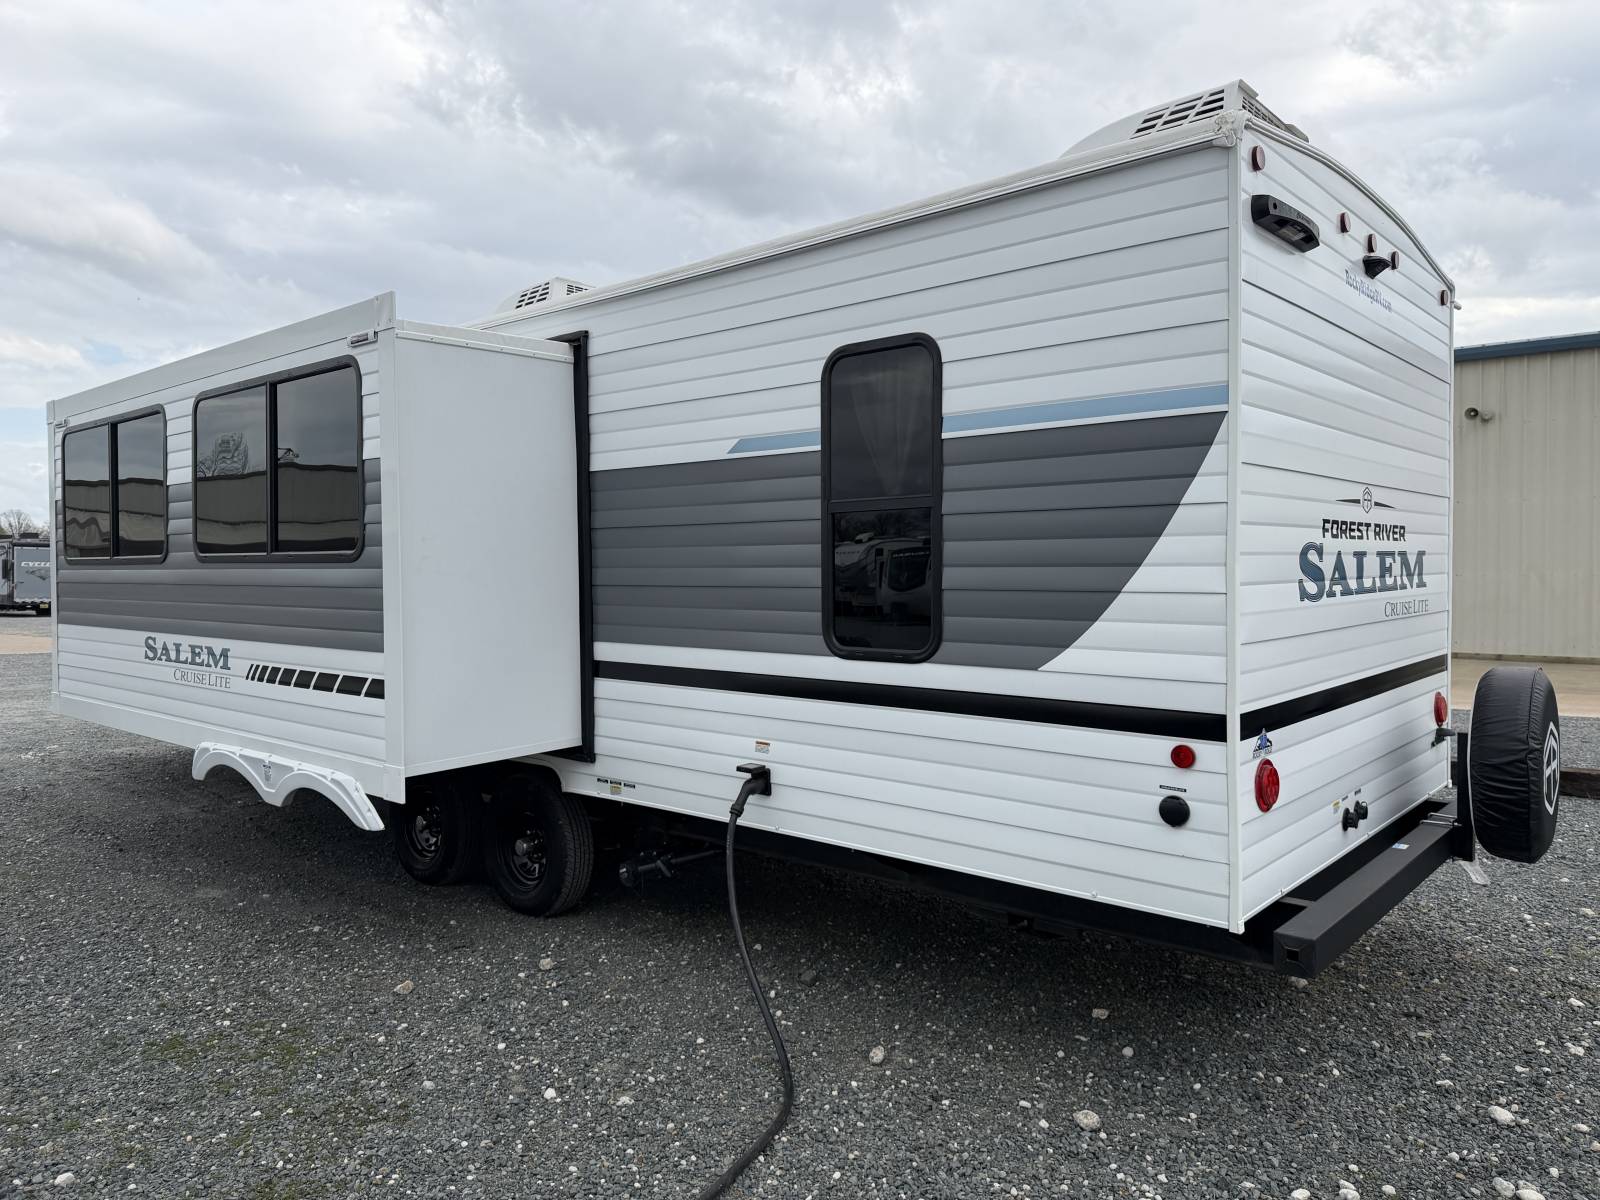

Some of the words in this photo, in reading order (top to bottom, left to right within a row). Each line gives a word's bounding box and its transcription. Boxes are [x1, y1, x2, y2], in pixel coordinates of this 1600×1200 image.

[1322, 519, 1371, 540] FOREST
[1374, 523, 1406, 541] RIVER
[1299, 542, 1427, 602] SALEM
[144, 636, 231, 670] SALEM
